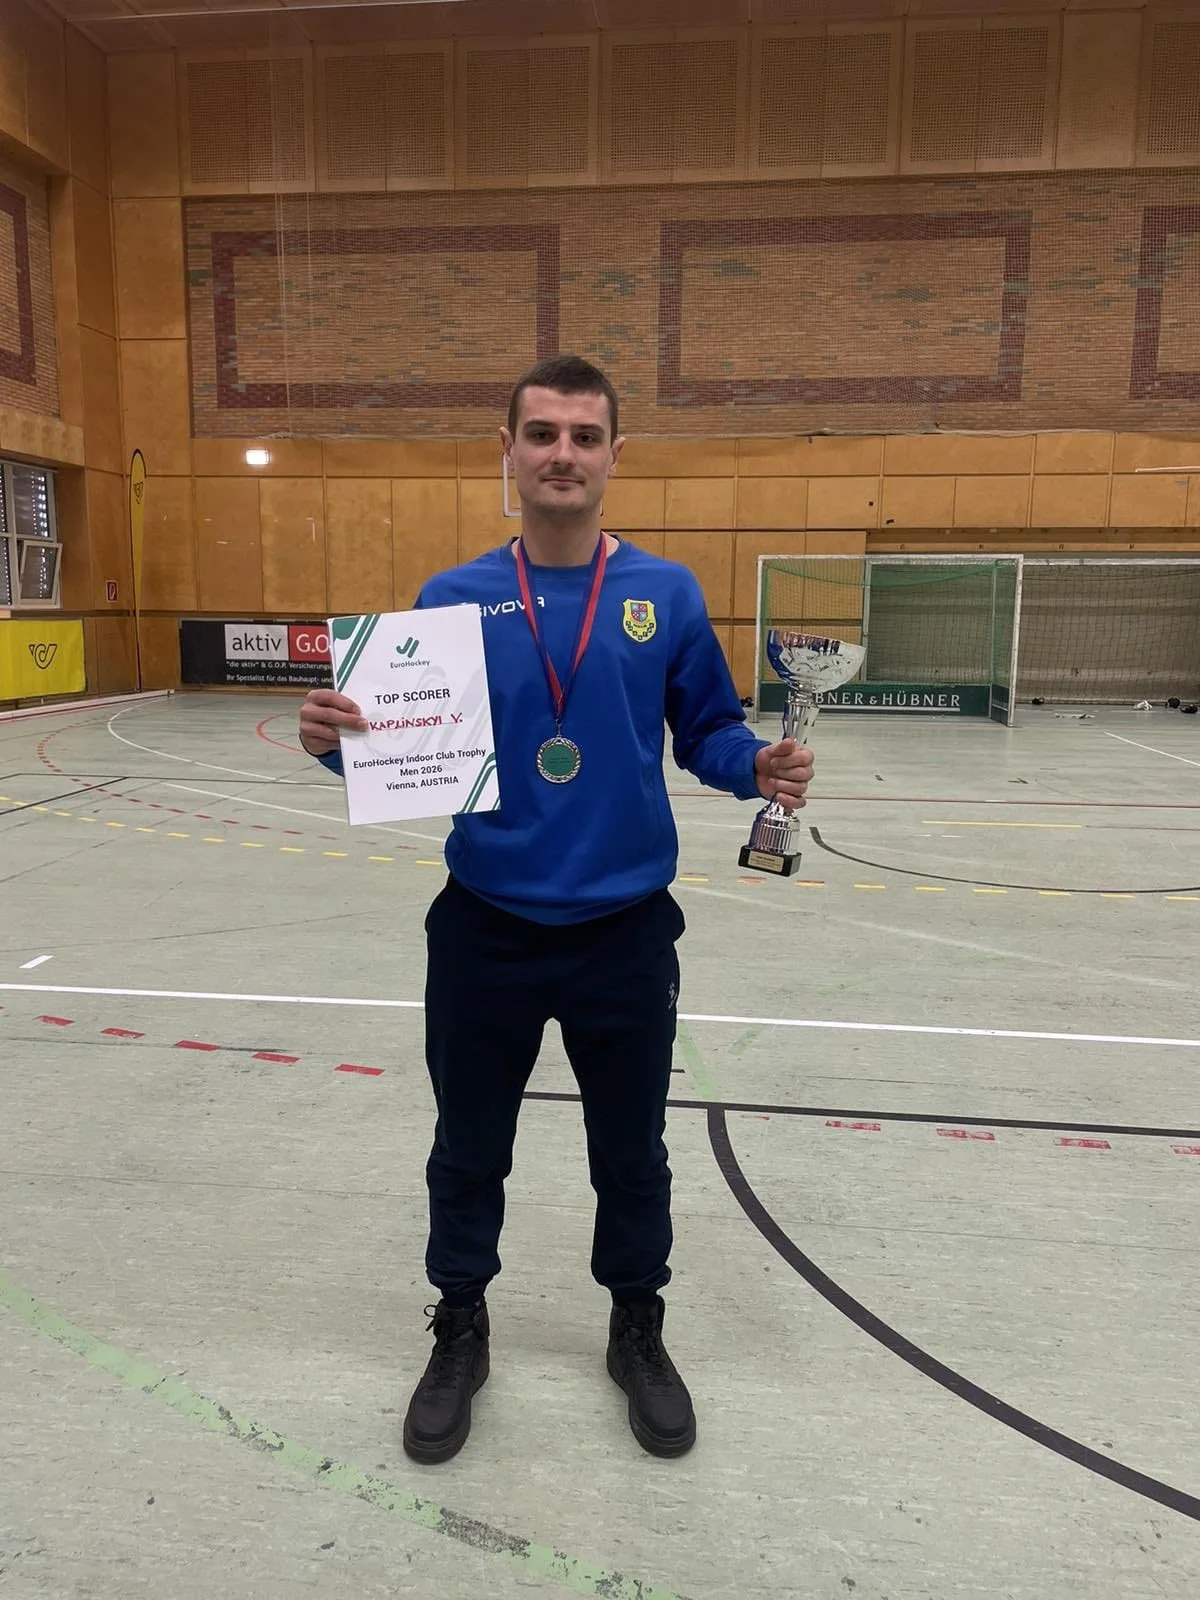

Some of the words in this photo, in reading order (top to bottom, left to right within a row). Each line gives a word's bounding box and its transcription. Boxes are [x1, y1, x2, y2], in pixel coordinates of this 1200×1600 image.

[232, 633, 282, 651] aktiv
[390, 660, 431, 669] EuroHockey
[236, 674, 265, 683] Spezialist
[375, 693, 400, 705] TOP
[403, 688, 450, 702] SCORER
[869, 696, 877, 705] &
[882, 691, 961, 707] HÜBNER
[353, 757, 404, 769] EuroHockey
[406, 753, 434, 764] Indoor
[435, 751, 455, 761] Club
[457, 748, 486, 759] Trophy
[400, 767, 419, 777] Men
[420, 765, 443, 775] 2026
[386, 780, 419, 791] Vienna,
[420, 776, 459, 788] AUSTRIA
